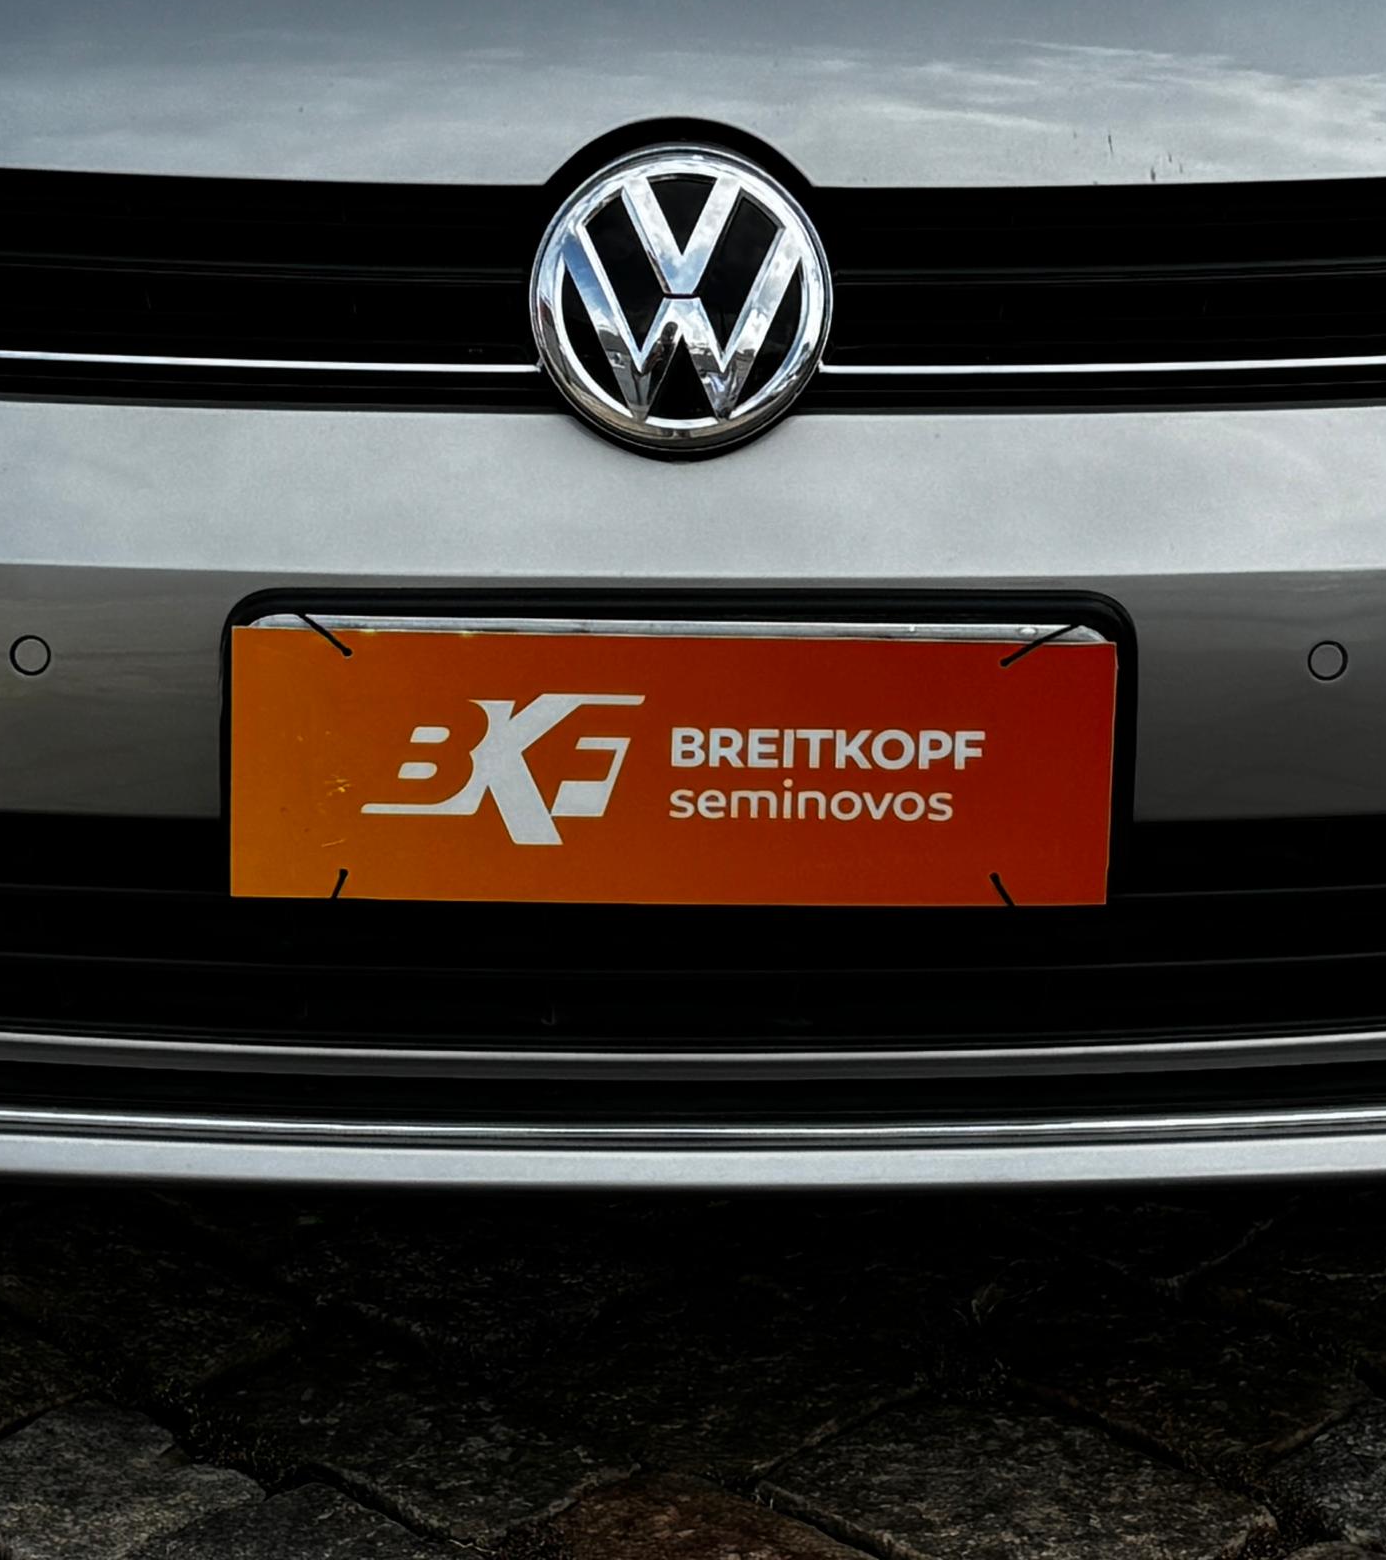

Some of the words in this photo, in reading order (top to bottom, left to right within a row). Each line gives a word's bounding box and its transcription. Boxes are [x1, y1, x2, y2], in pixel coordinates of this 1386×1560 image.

[553, 165, 808, 432] VW
[670, 726, 986, 770] BREITKOPF
[669, 778, 954, 822] seminovos
